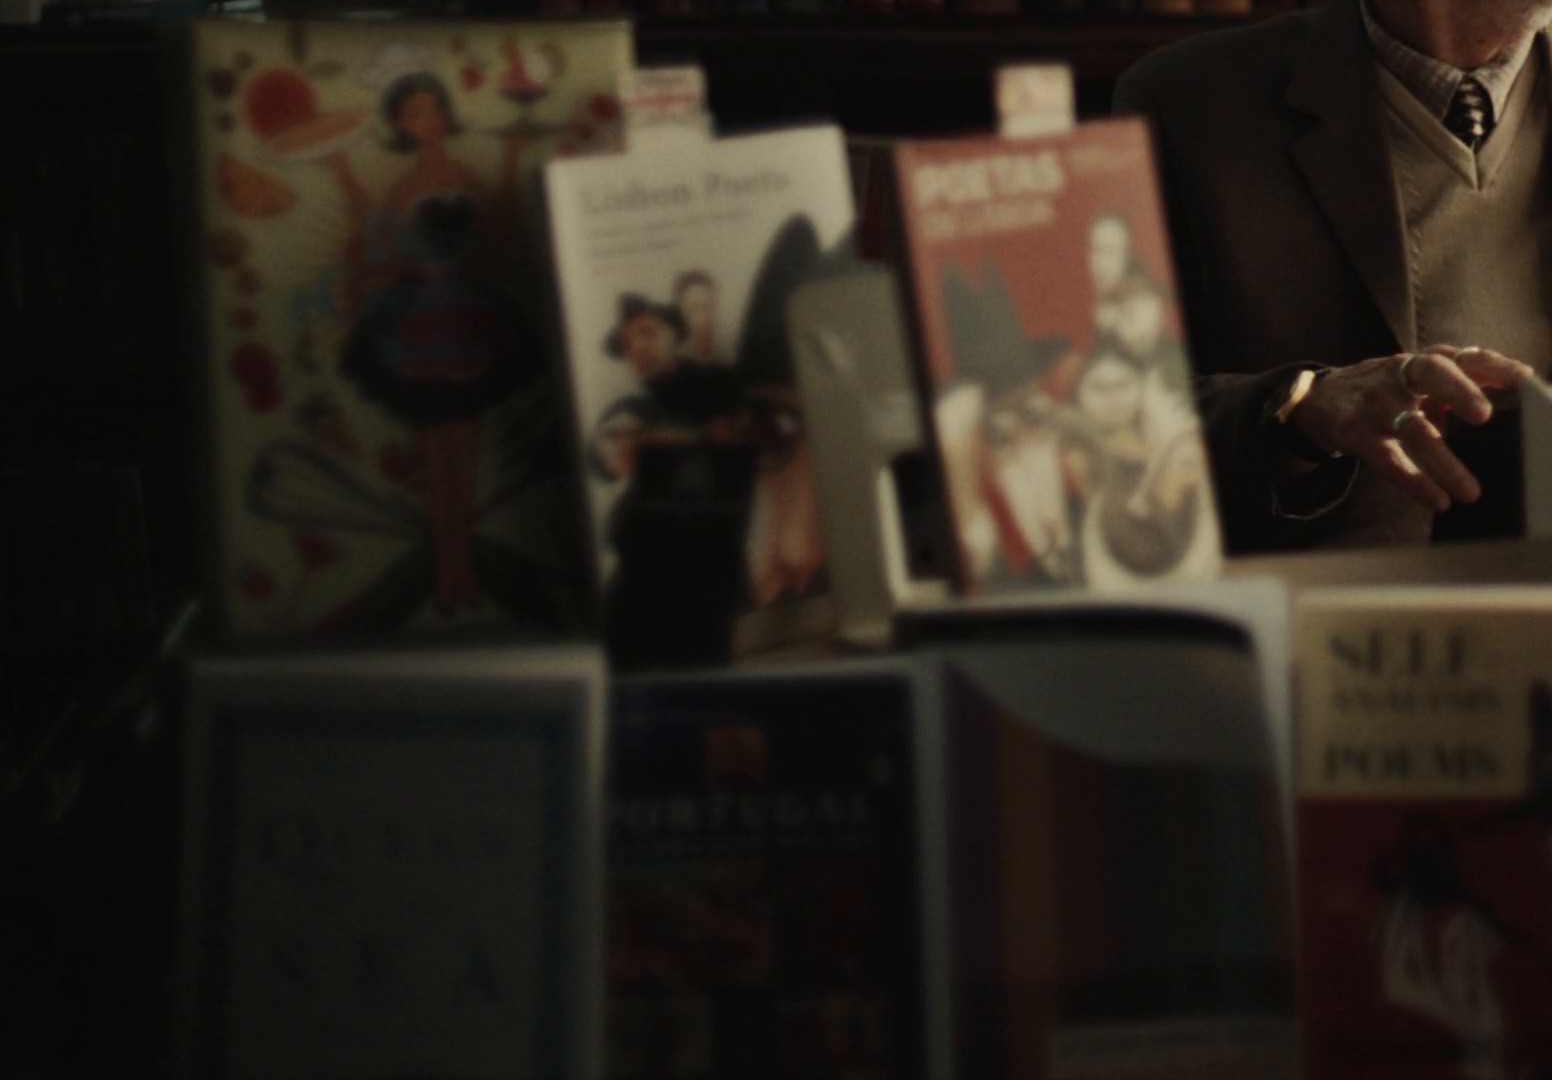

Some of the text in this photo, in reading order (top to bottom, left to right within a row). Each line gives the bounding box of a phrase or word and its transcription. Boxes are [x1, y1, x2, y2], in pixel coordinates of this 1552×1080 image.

[583, 179, 692, 211] Lisbon
[912, 149, 1064, 208] POETAS
[1329, 628, 1478, 677] SELF
[1324, 742, 1499, 782] POEMS
